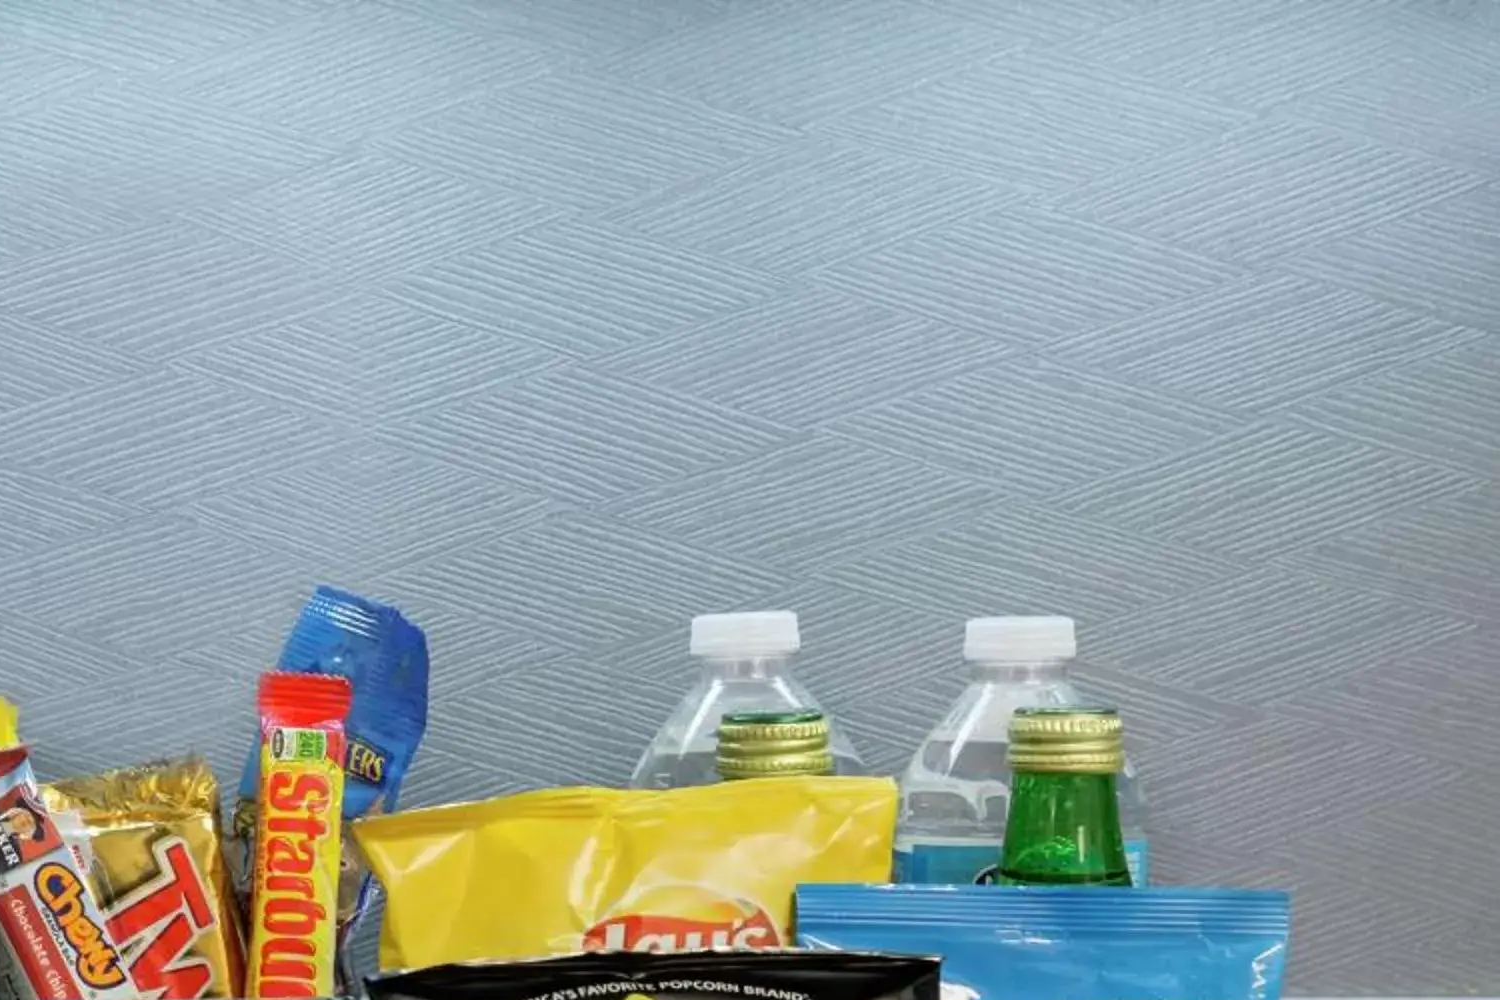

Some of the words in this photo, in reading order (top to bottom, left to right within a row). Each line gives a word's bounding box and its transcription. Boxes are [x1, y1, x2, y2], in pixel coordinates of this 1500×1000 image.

[350, 743, 386, 783] ERS
[11, 898, 50, 966] Chocolate
[34, 862, 127, 989] Chewy
[577, 980, 655, 998] FAVORITE
[658, 979, 740, 994] POPCORN
